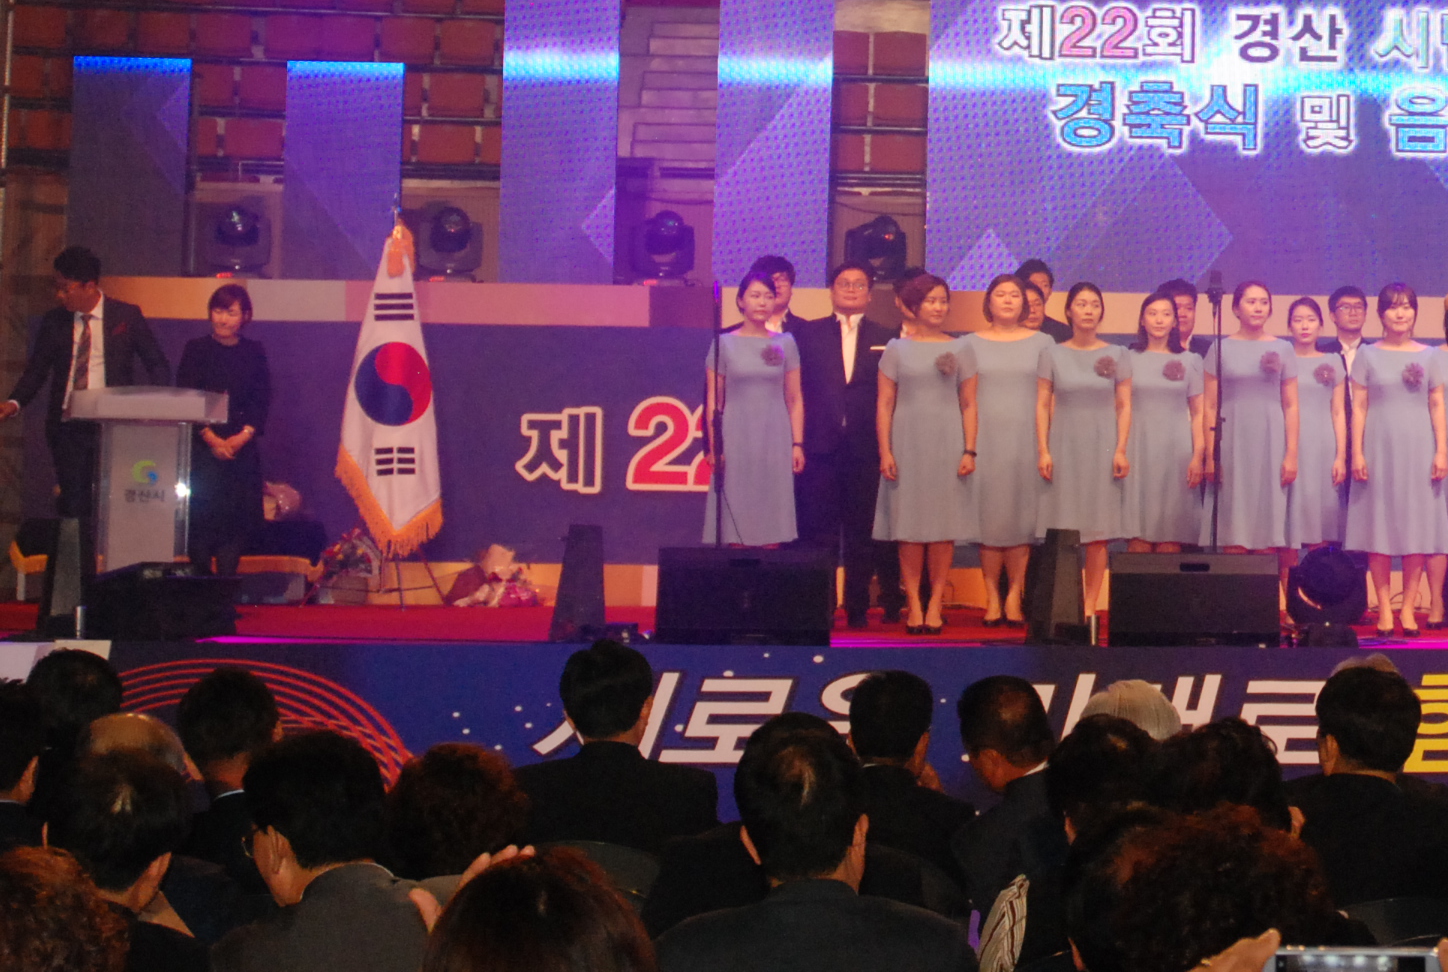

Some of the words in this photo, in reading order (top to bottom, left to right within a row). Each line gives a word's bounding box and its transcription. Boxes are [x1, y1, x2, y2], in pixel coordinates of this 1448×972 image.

[997, 3, 1196, 64] 제22회
[1233, 11, 1343, 63] 경산
[1051, 81, 1260, 151] 경축식
[1300, 93, 1354, 150] 및
